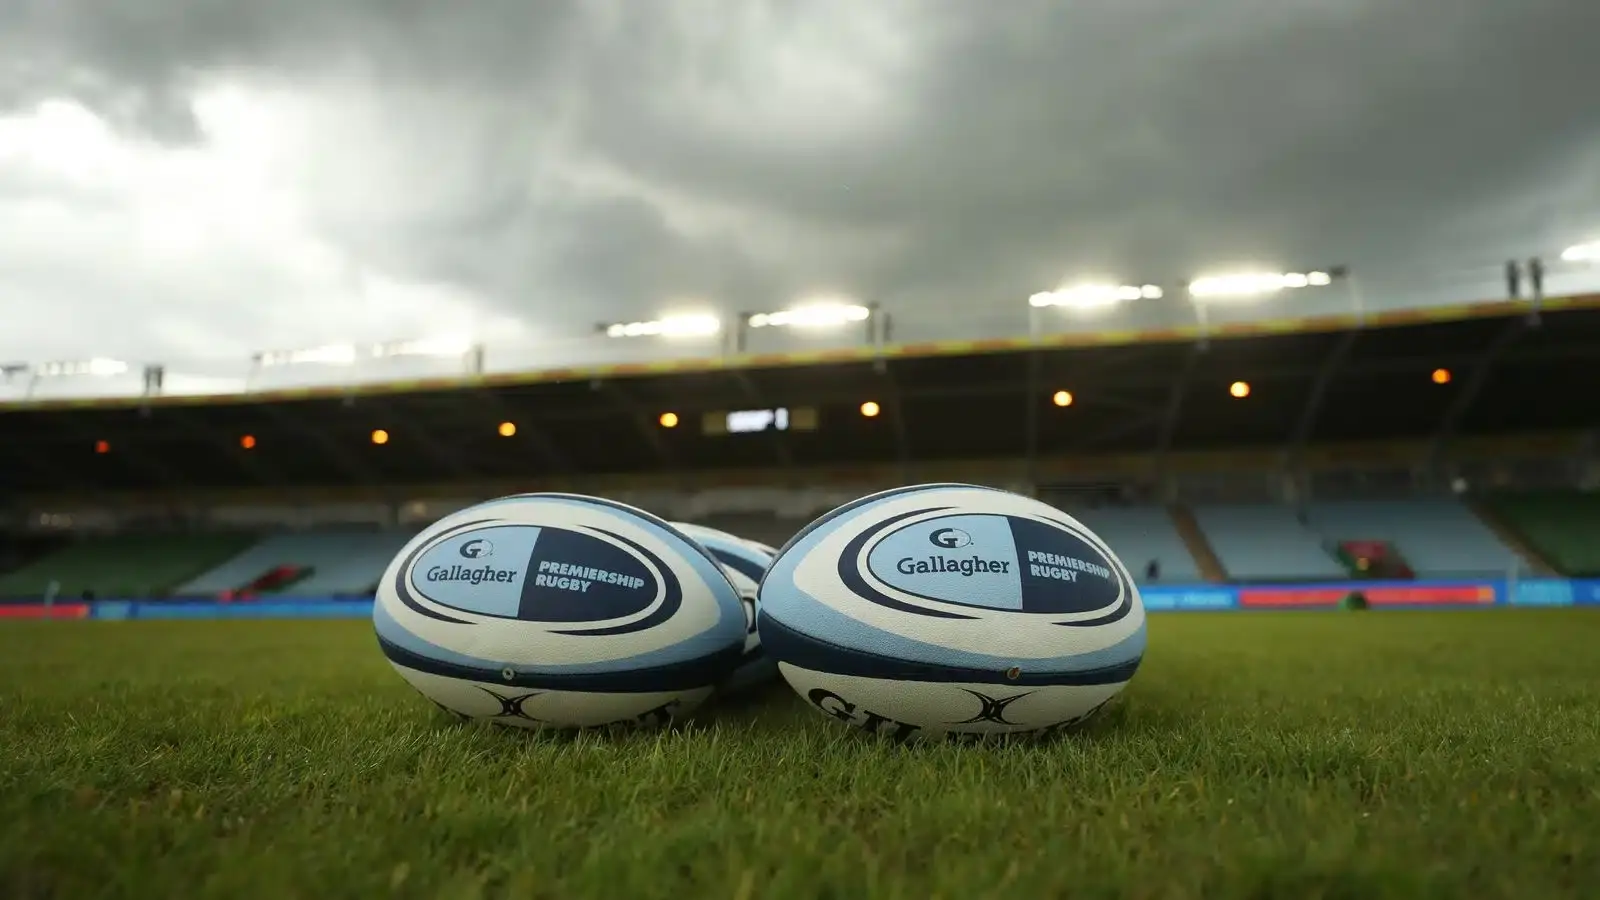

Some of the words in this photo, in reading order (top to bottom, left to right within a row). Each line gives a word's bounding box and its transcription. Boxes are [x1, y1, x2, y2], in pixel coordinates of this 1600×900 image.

[426, 565, 518, 585] Gallagher
[538, 560, 645, 590] PREMIERSHIP
[896, 555, 1010, 577] Gallagher
[1027, 550, 1112, 580] PREMIERSHIP
[1030, 564, 1078, 583] RUGBY
[535, 574, 592, 593] RUGBY
